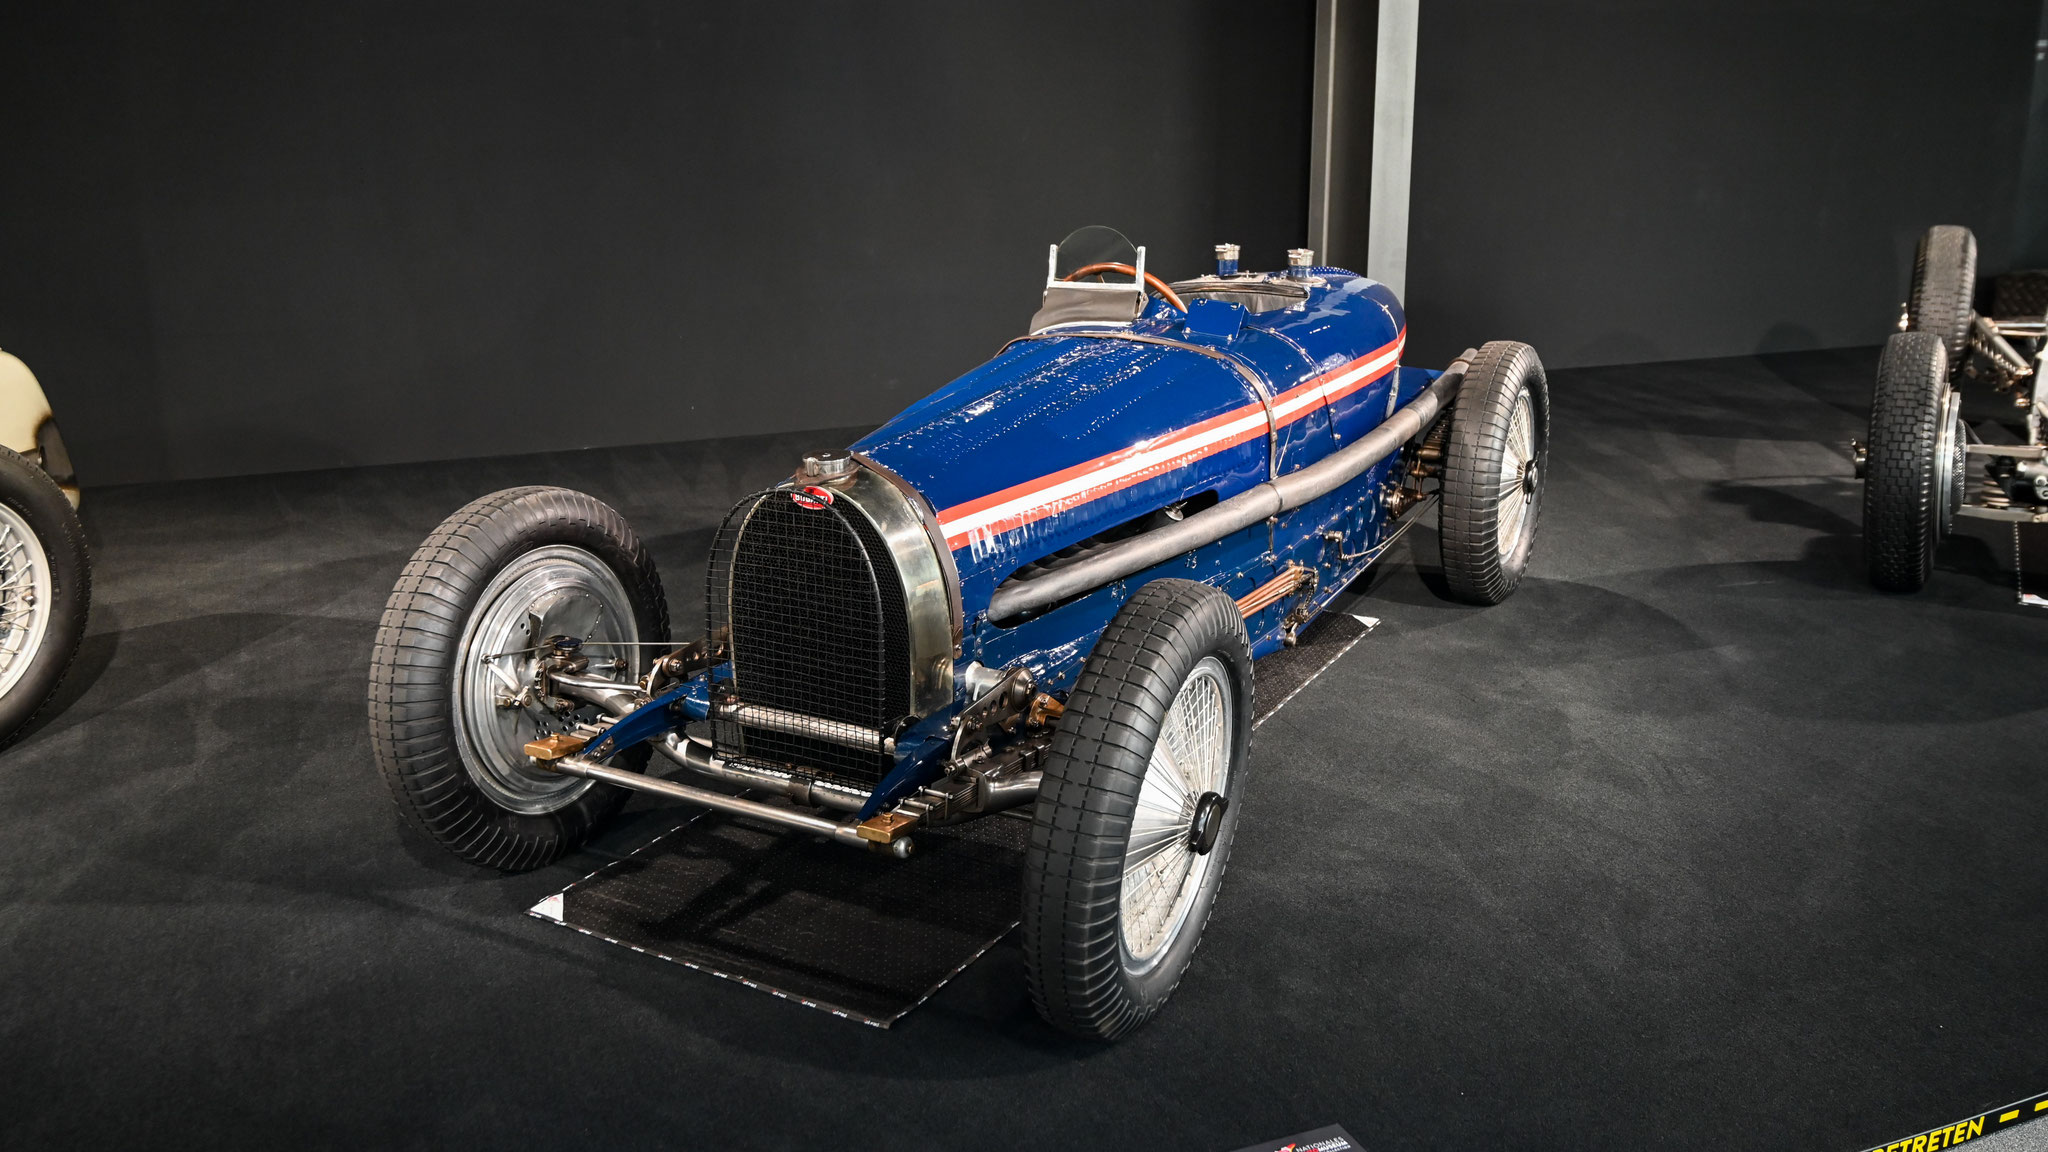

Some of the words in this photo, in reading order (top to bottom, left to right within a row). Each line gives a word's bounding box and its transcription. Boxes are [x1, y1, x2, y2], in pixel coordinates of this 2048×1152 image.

[795, 494, 828, 504] BUGTI
[1872, 1116, 1985, 1152] TRETEN
[1295, 1136, 1344, 1152] NATIONALES
